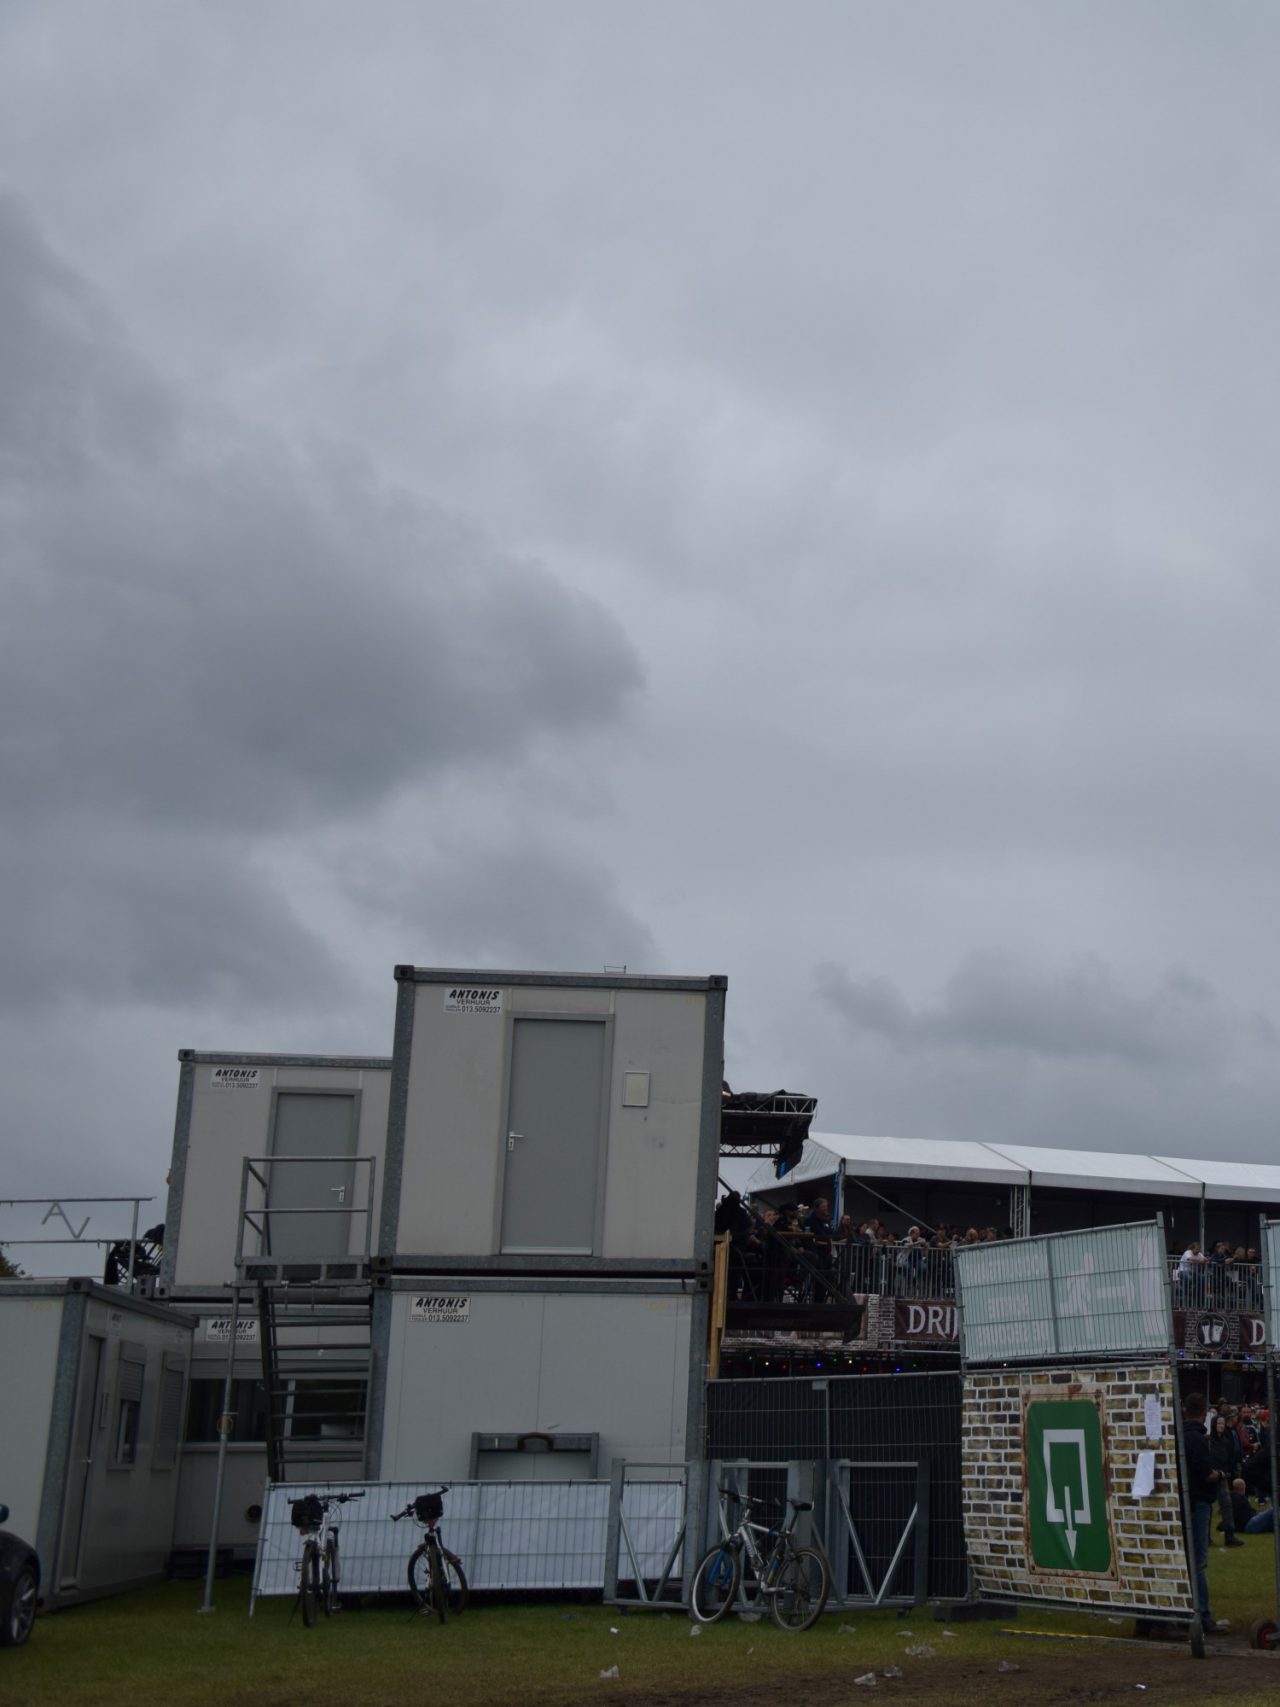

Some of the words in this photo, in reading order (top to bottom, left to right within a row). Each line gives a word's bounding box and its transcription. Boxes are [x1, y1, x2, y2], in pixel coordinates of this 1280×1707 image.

[449, 989, 500, 1000] ANTONIS
[215, 1069, 258, 1078] ANTONIS
[416, 1298, 468, 1308] ANTONIS
[211, 1320, 255, 1329] ANTNIS
